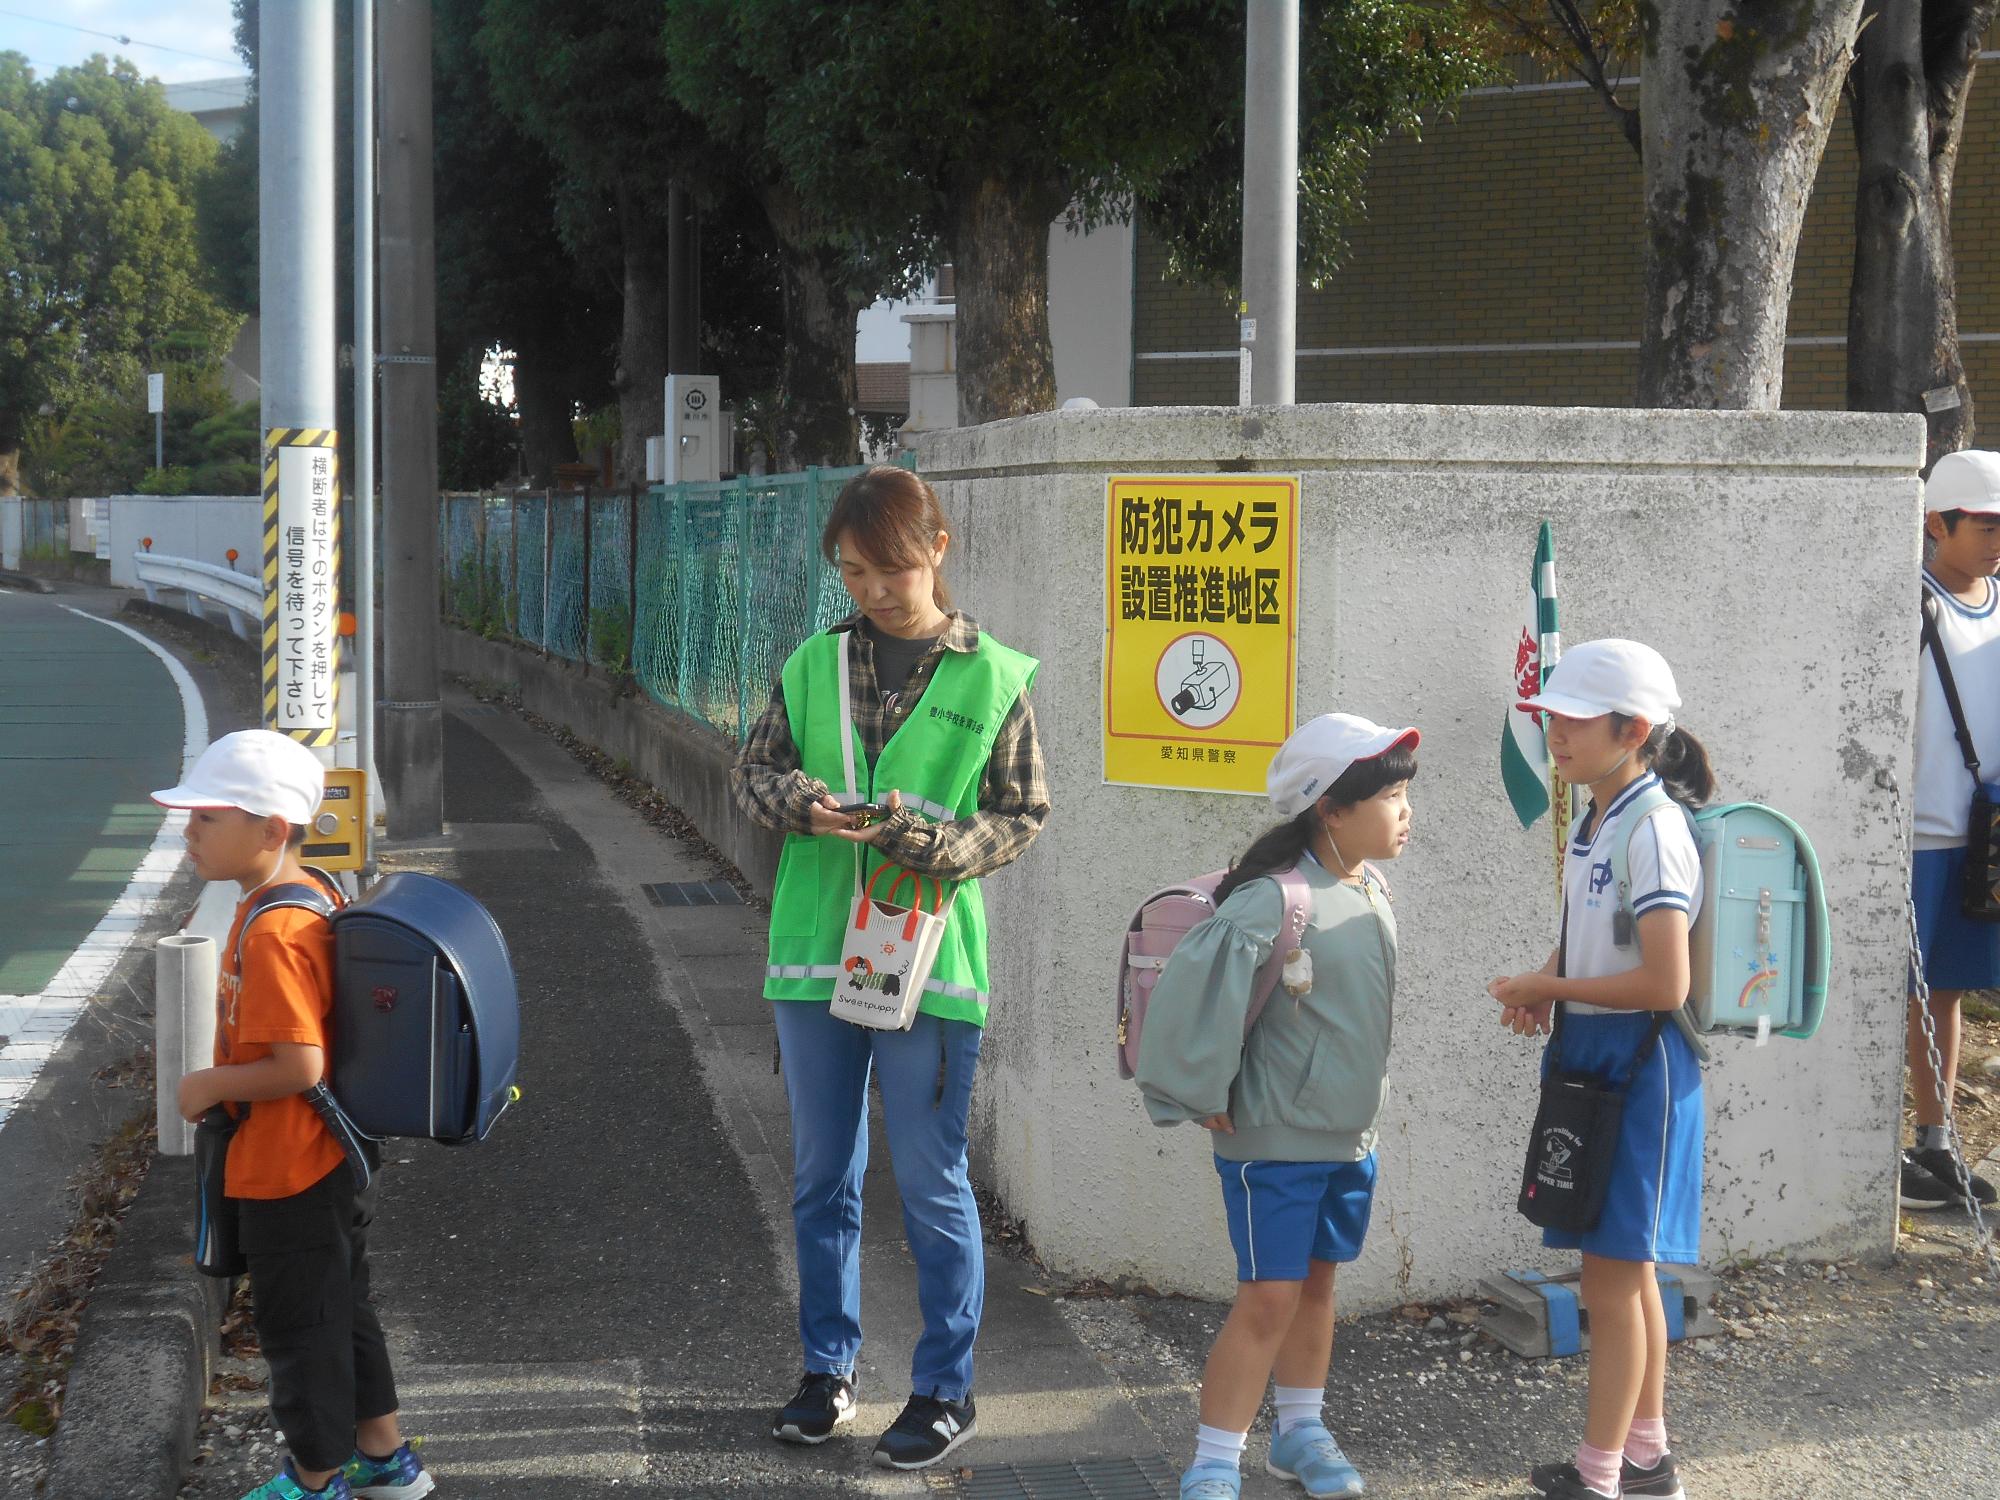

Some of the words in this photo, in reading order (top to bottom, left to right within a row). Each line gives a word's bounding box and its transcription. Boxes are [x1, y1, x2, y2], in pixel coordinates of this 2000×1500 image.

[1120, 496, 1280, 555] 防犯カメラ
[285, 526, 305, 718] 信号を待って下さい
[1120, 564, 1281, 625] 設置推進地区
[1160, 745, 1237, 765] 愛知県警察
[838, 994, 898, 1015] Sweetpuppy
